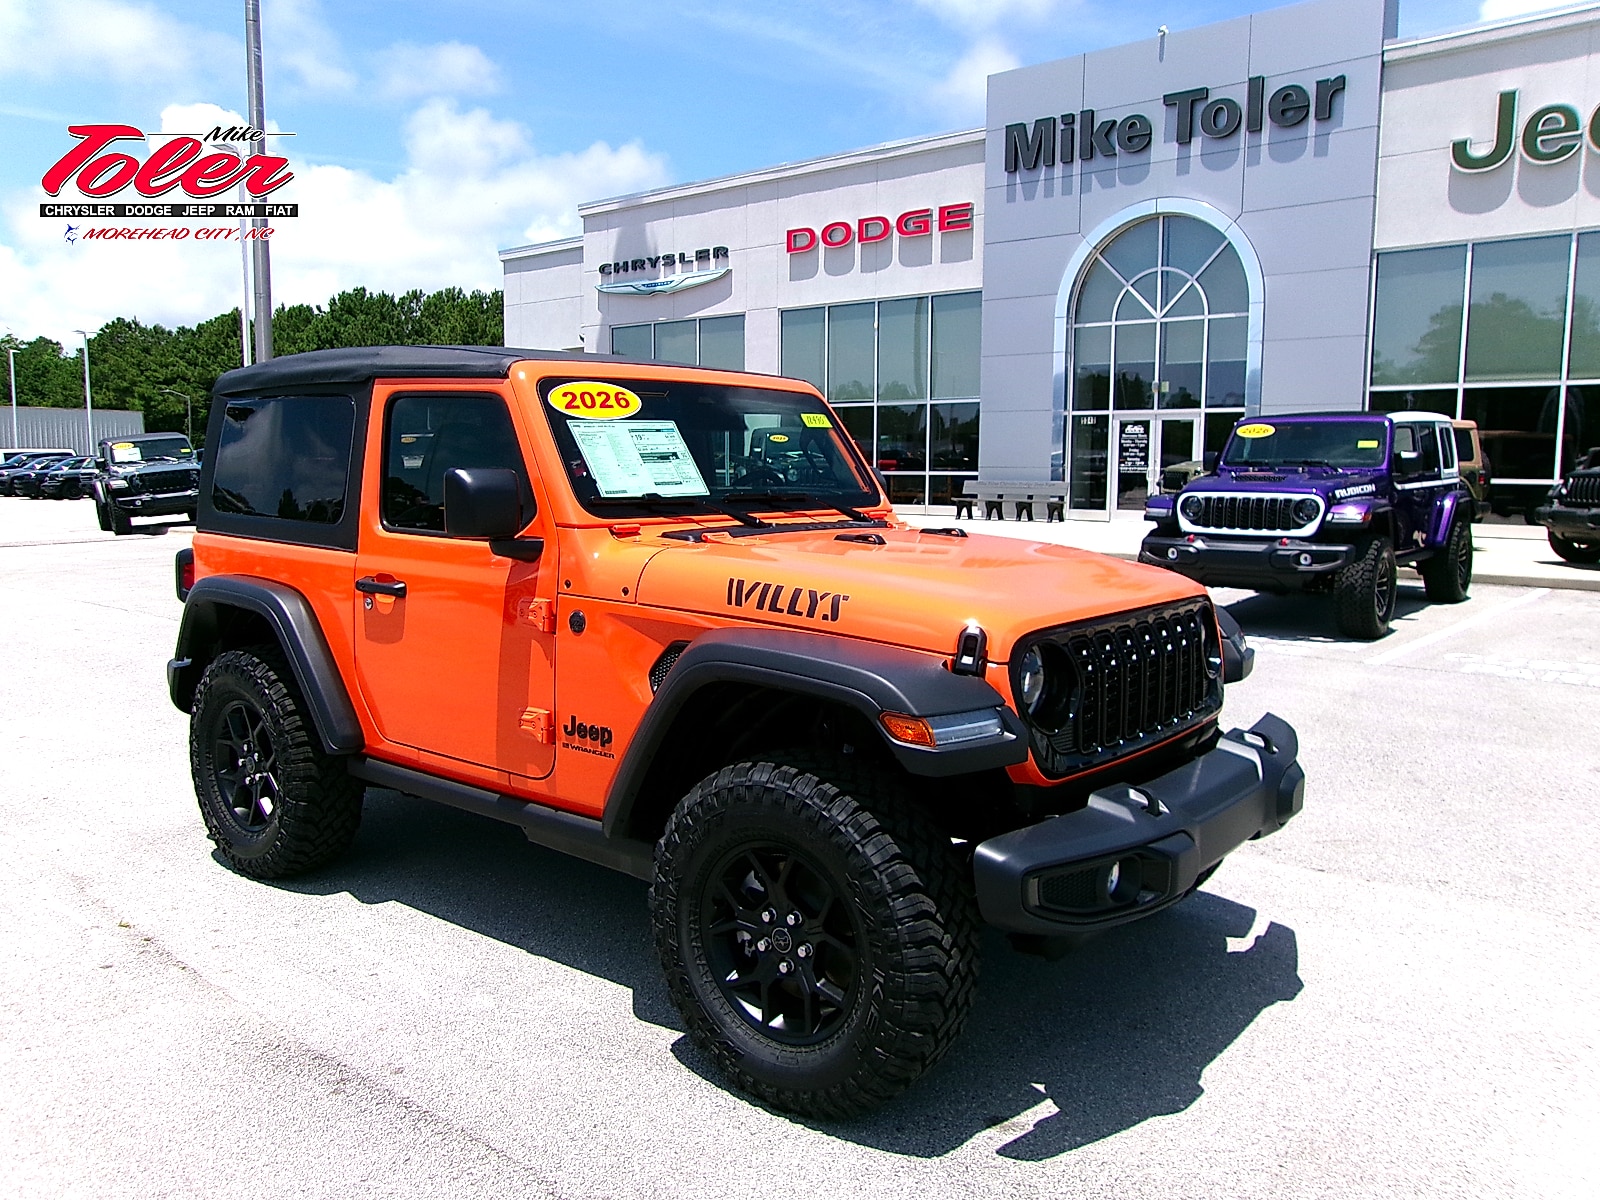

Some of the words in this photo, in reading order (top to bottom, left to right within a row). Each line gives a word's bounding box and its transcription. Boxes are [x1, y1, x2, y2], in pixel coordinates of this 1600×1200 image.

[1003, 107, 1153, 173] Mike
[1162, 74, 1347, 145] Toler
[786, 202, 973, 255] DODGE
[598, 245, 729, 275] CHRYSLER
[561, 390, 630, 410] 2026
[1334, 483, 1376, 499] RUBICON
[727, 577, 850, 622] WILLYS
[563, 715, 613, 747] Jeep
[570, 744, 615, 759] WRANGLER
